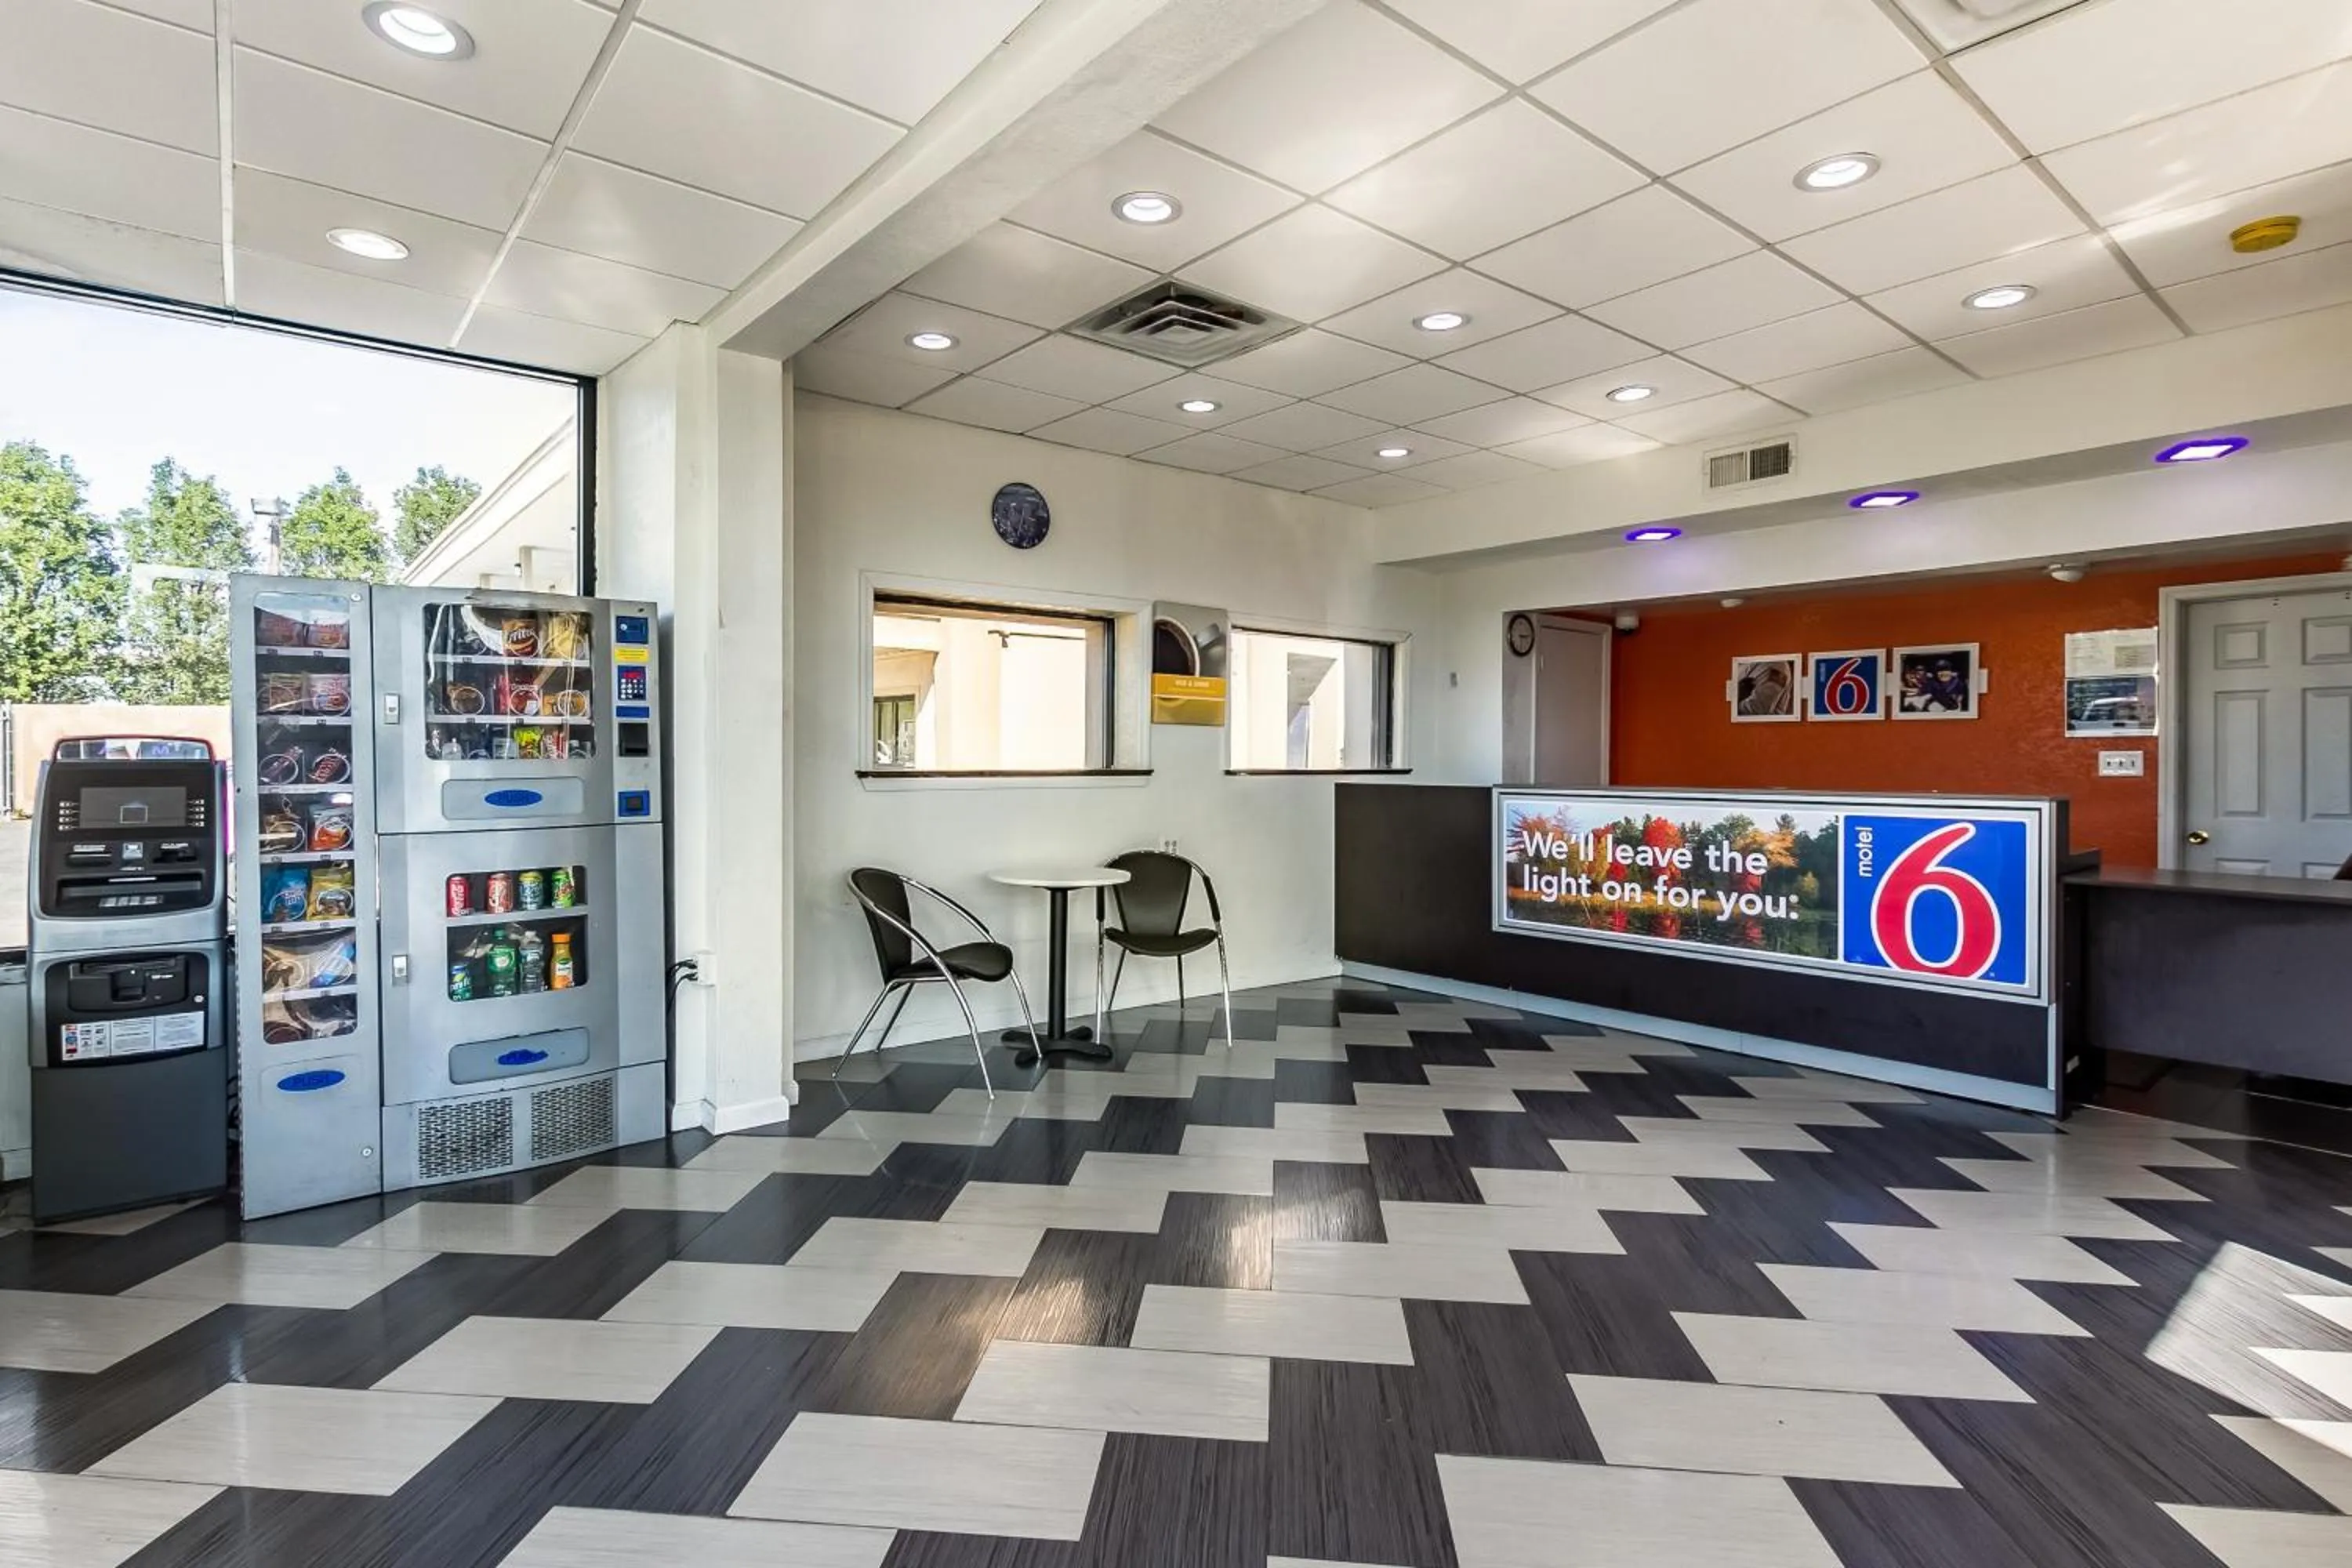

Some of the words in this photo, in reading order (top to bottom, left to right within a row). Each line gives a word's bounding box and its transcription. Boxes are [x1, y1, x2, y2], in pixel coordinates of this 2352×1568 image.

[1825, 658, 1870, 716] 6
[1523, 830, 1594, 862] We'll
[1607, 833, 1693, 869] leave
[1704, 840, 1769, 875] the
[1855, 826, 1873, 878] motel
[1523, 864, 1592, 902] light
[1602, 880, 1642, 903] on
[1654, 874, 1706, 909] for
[1870, 822, 2002, 980] 6
